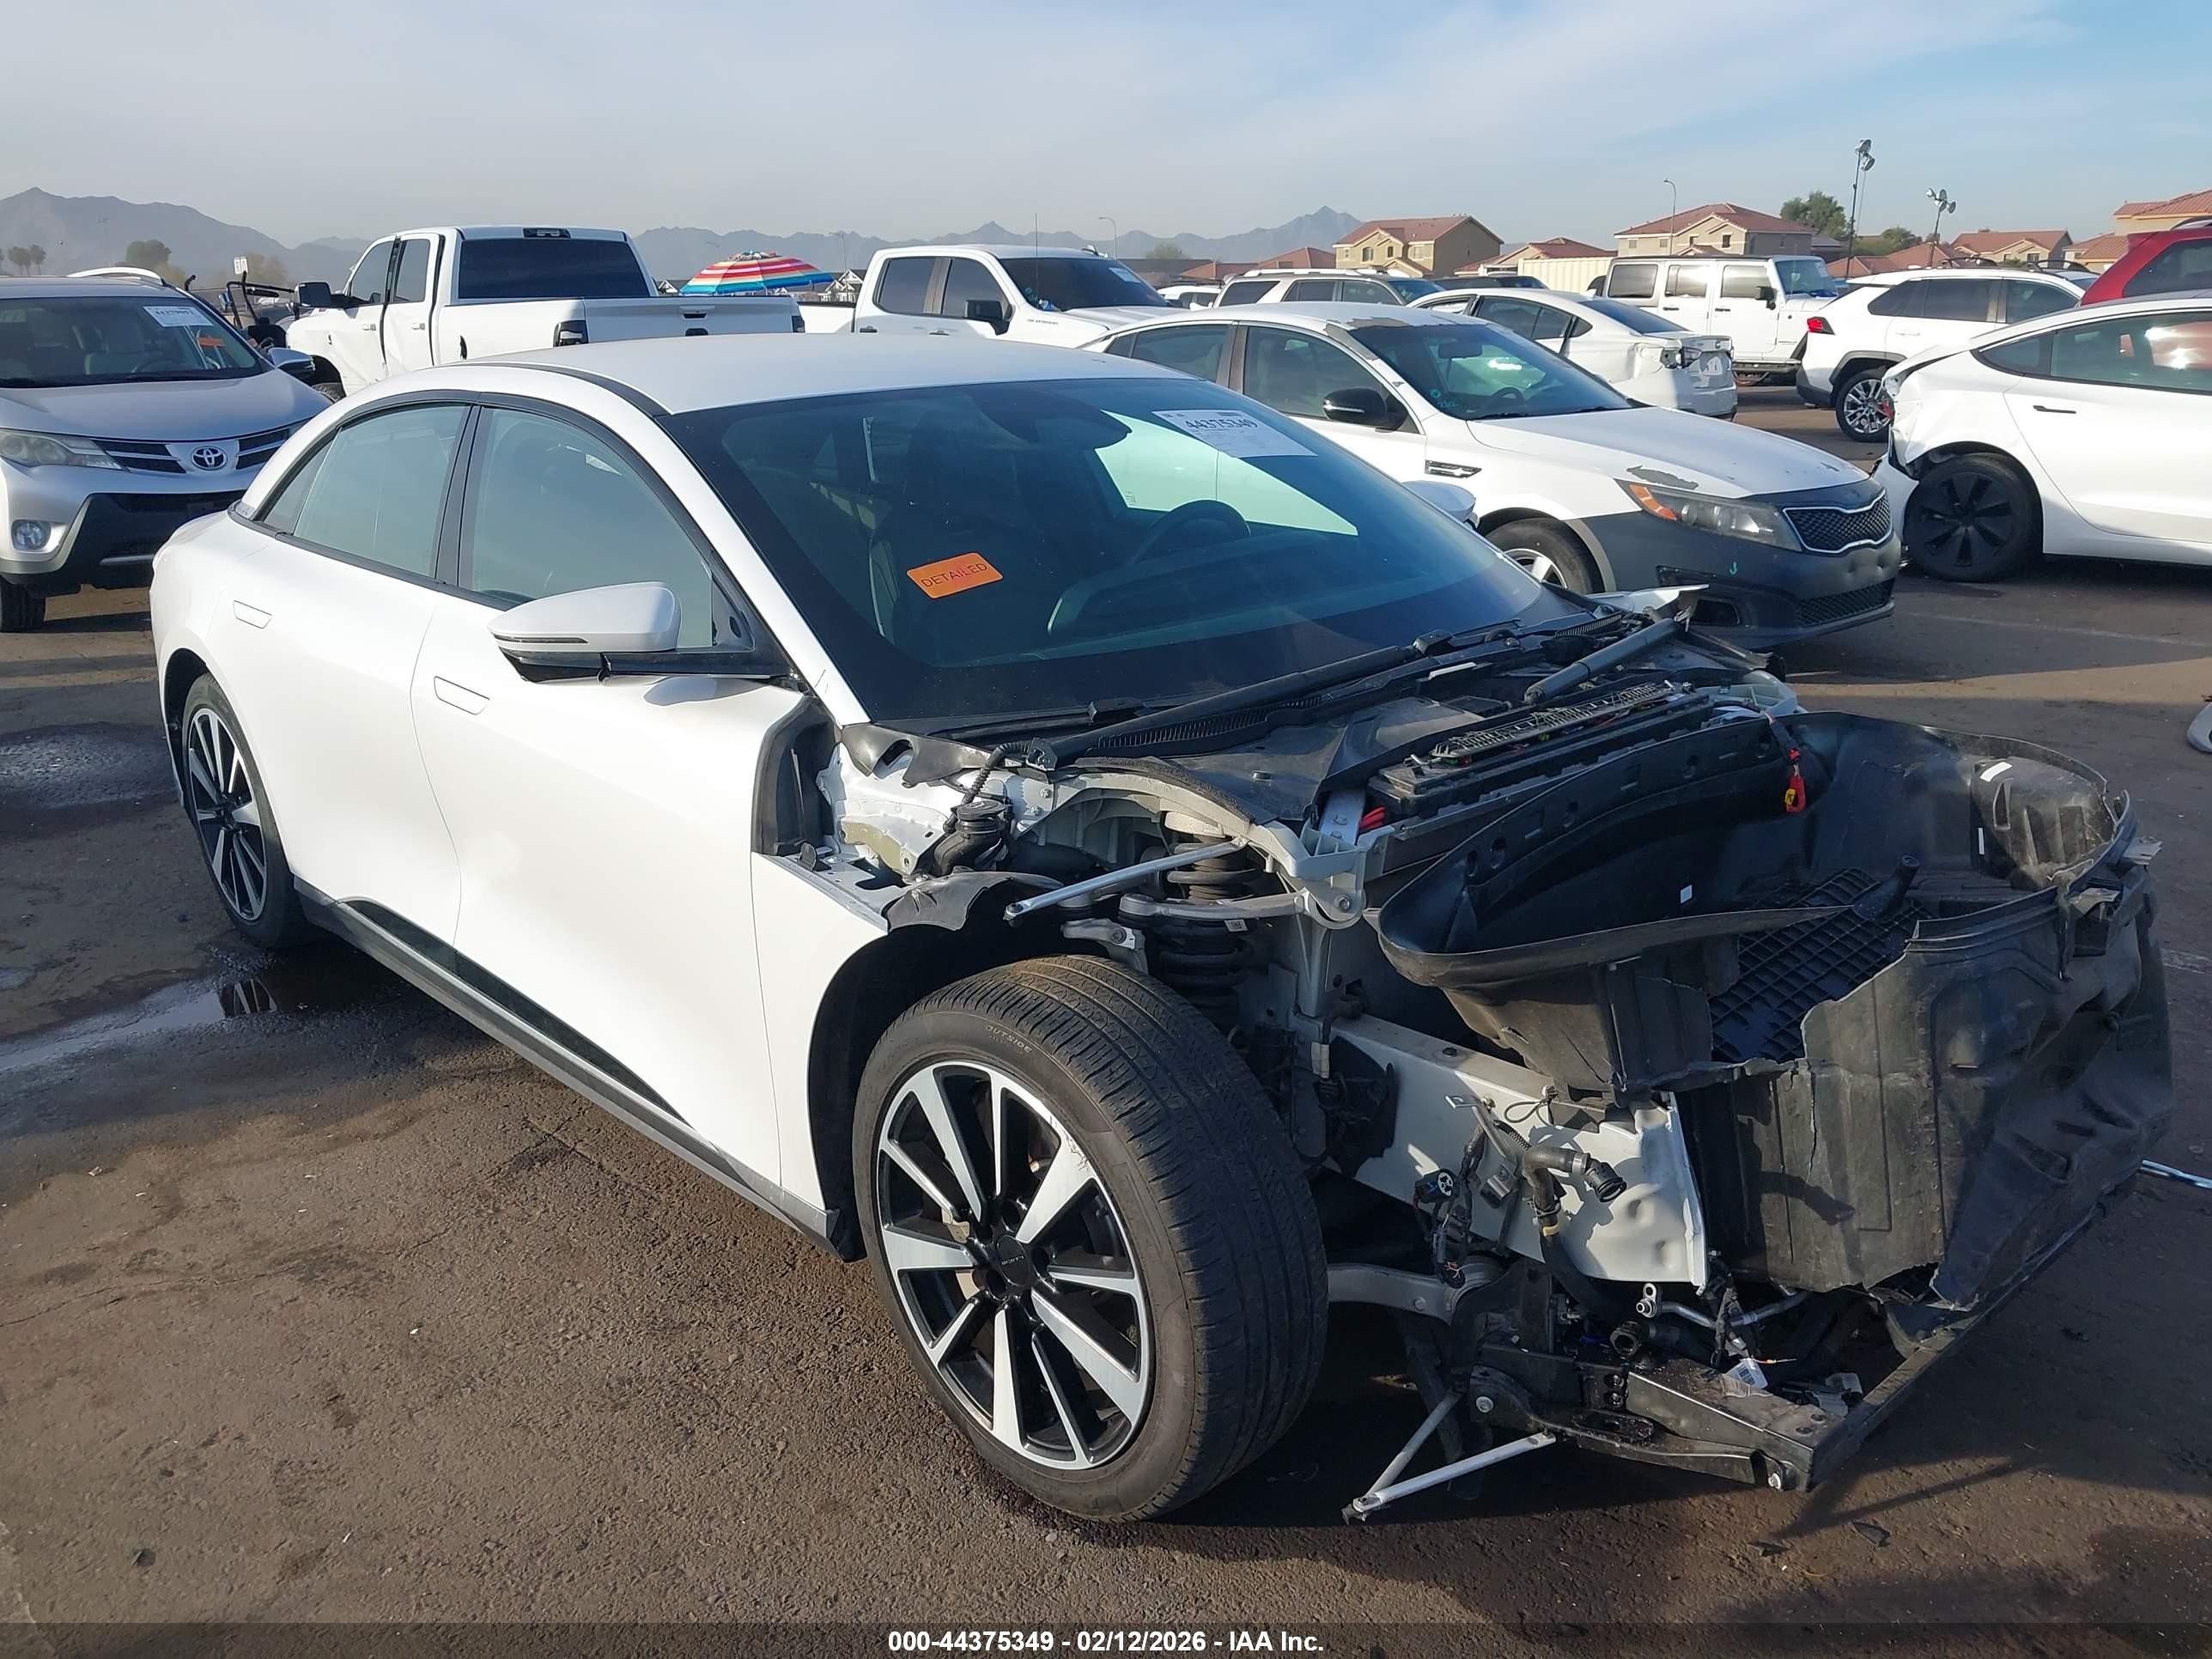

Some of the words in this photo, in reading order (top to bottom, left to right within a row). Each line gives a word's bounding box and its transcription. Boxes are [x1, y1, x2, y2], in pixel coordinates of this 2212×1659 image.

[1185, 418, 1258, 429] 44375349
[921, 563, 988, 587] DETAILED
[985, 1024, 1032, 1053] OUTSIDE
